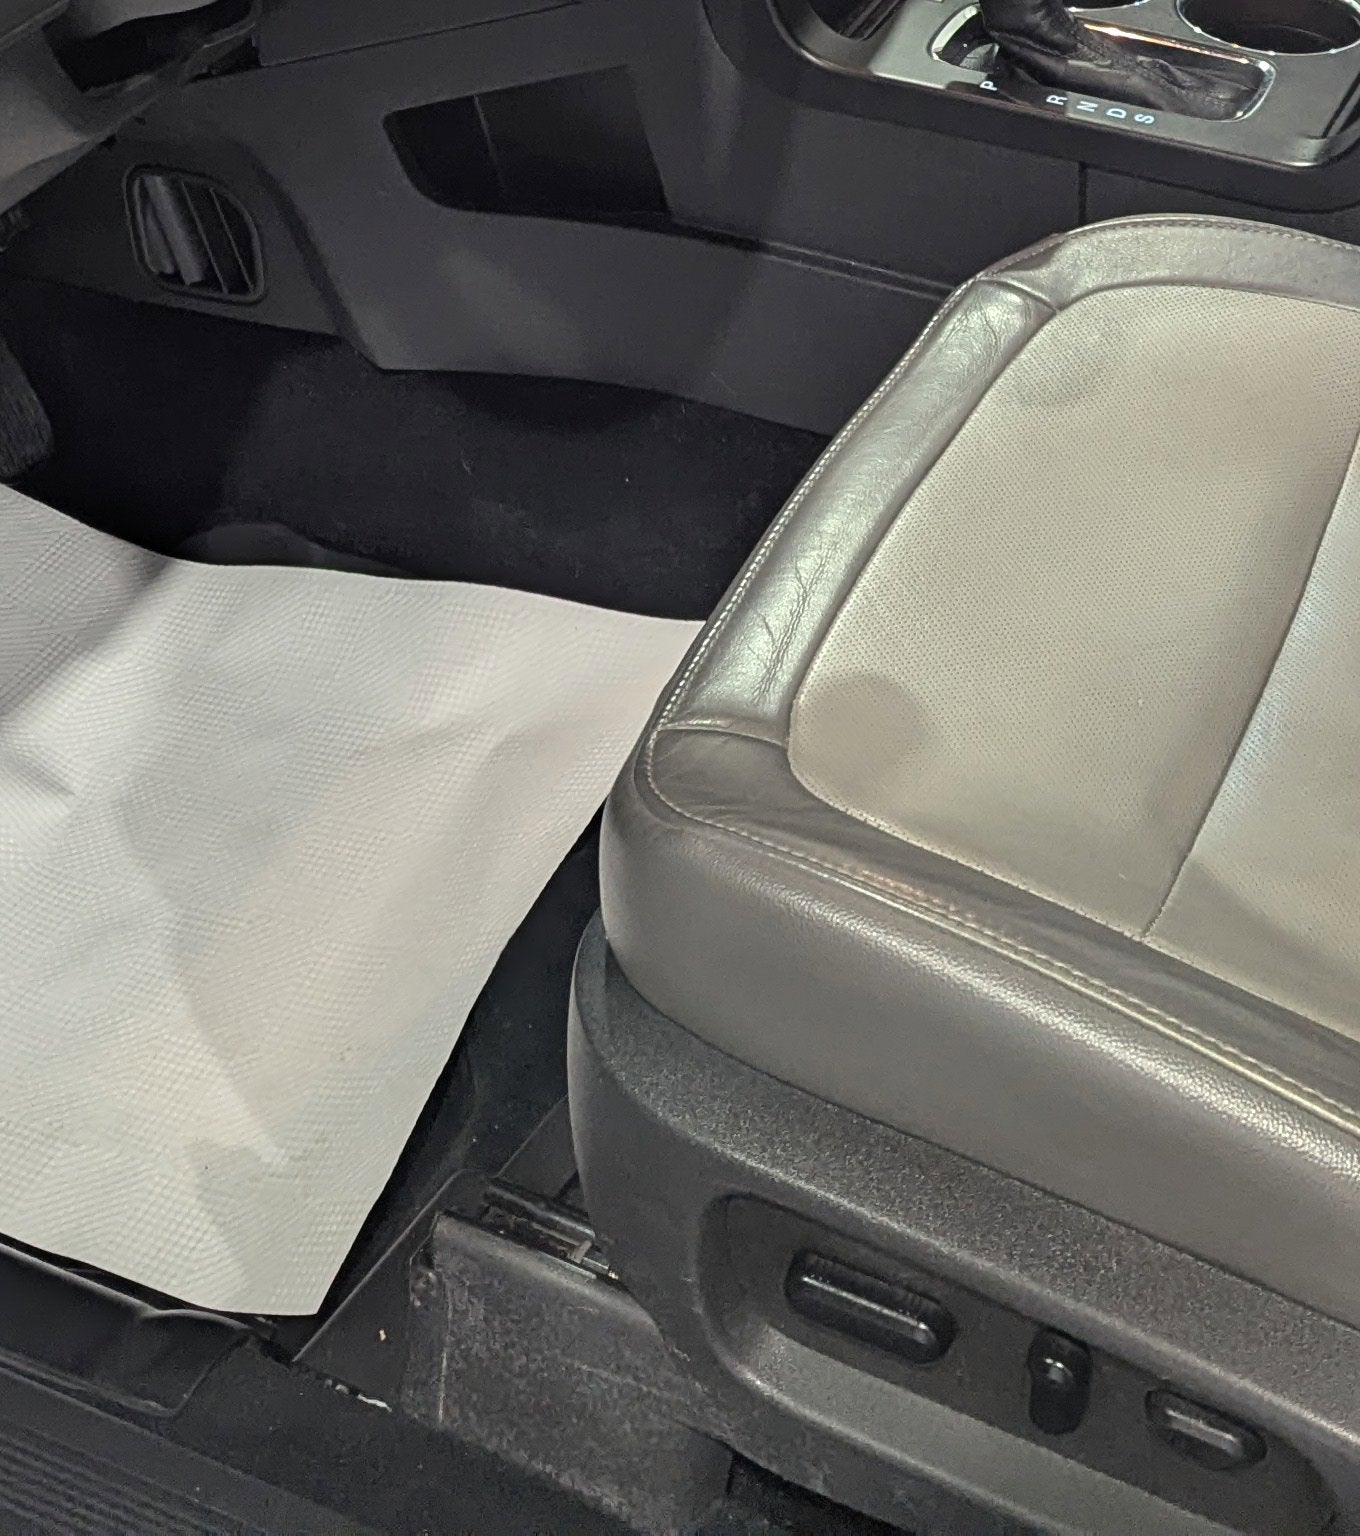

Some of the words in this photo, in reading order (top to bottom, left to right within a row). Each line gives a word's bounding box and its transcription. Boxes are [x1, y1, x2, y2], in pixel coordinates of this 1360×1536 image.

[979, 80, 998, 91] P
[1046, 94, 1068, 106] R
[1076, 100, 1099, 113] N
[1106, 108, 1128, 119] D
[1134, 114, 1155, 124] S
